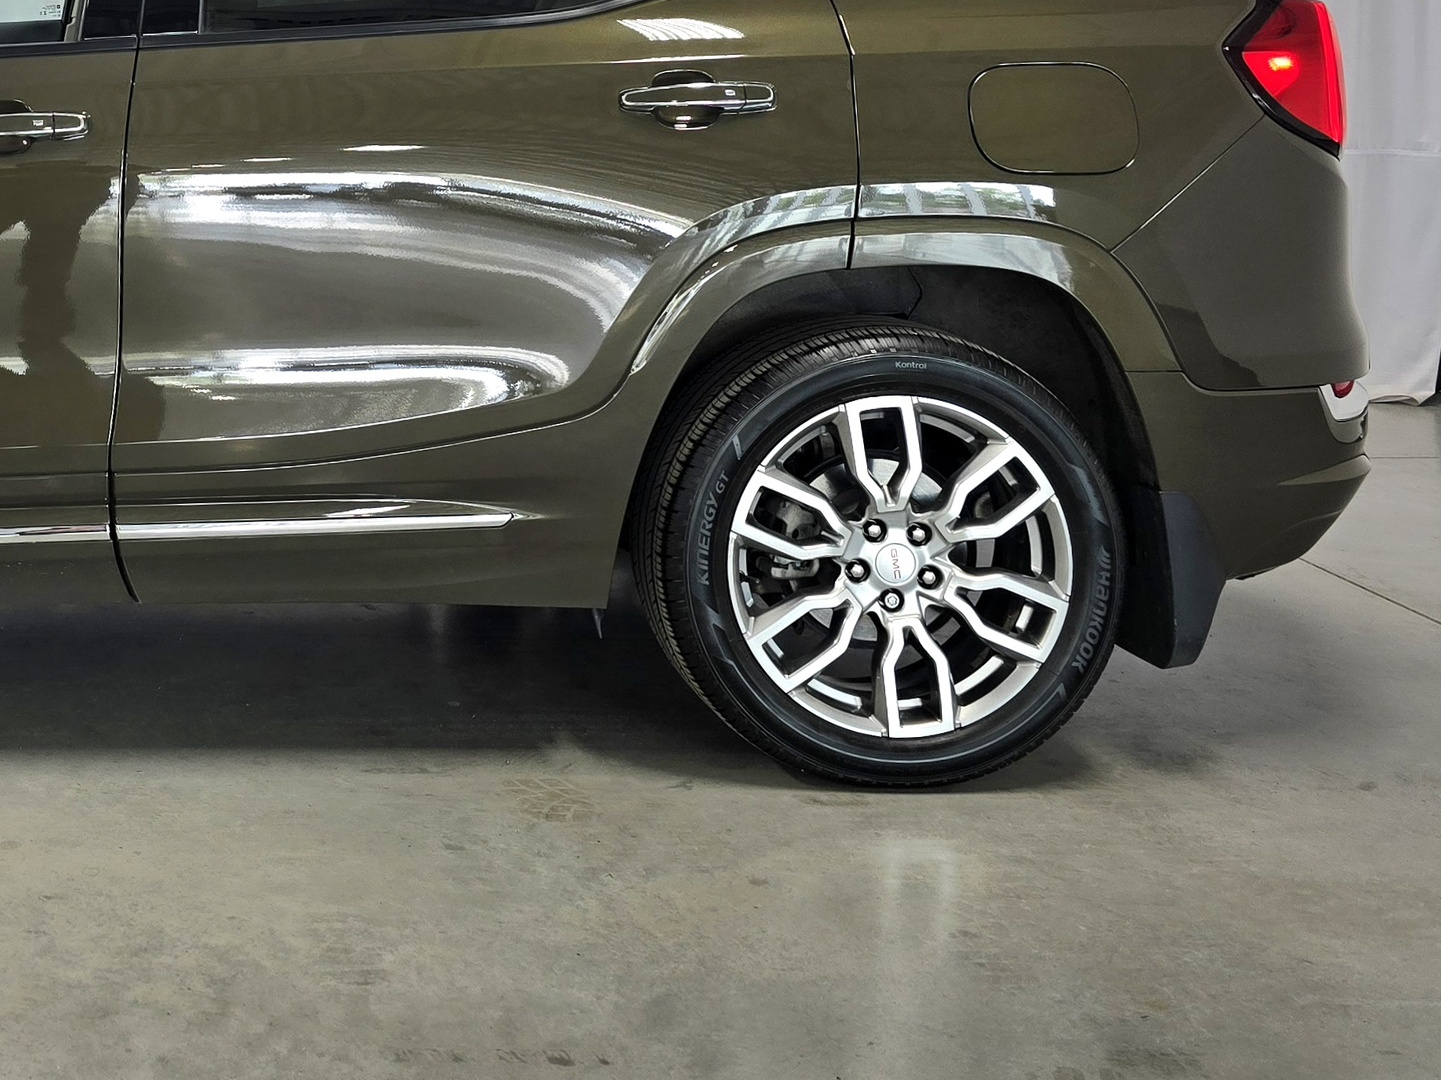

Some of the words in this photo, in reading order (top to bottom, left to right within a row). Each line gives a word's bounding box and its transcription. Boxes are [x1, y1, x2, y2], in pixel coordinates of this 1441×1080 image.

[895, 361, 927, 369] Kontrol
[715, 469, 730, 495] GT
[890, 548, 902, 580] GMC
